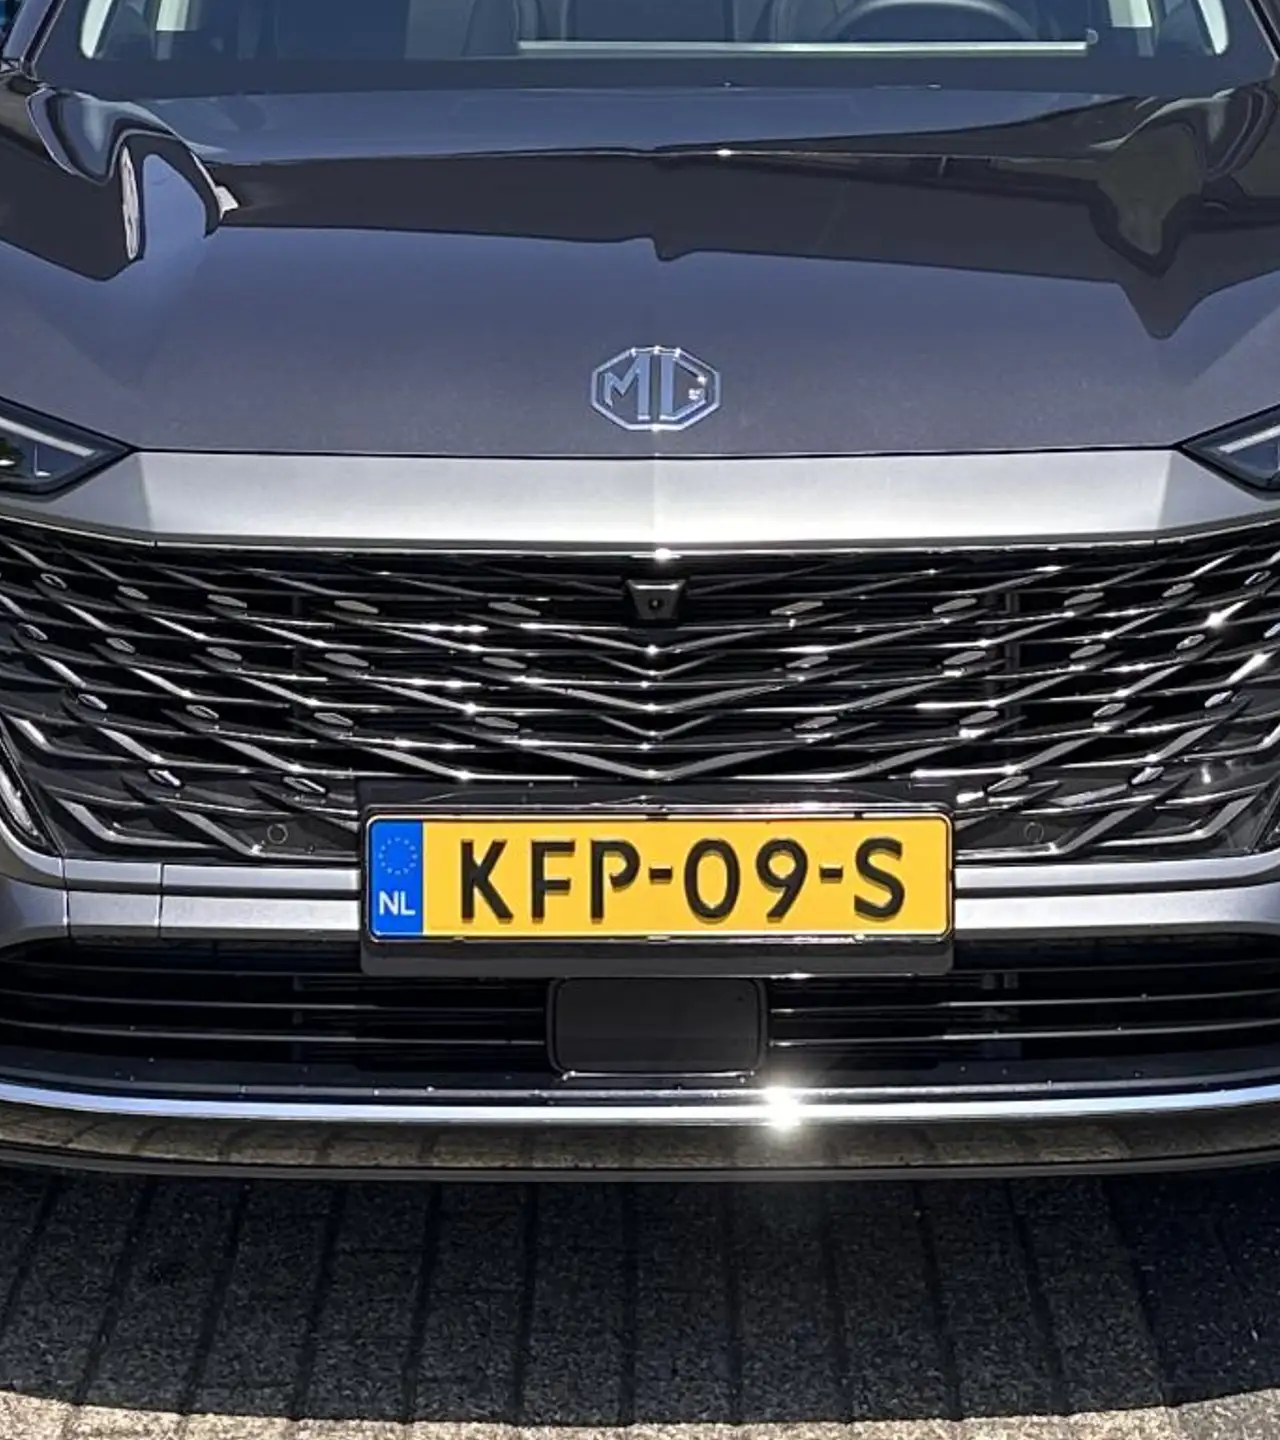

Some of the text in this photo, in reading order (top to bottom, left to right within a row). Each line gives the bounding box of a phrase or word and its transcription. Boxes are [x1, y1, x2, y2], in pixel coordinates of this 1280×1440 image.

[596, 347, 713, 425] MG
[378, 889, 417, 917] NL
[458, 837, 907, 924] KFP-09-S
